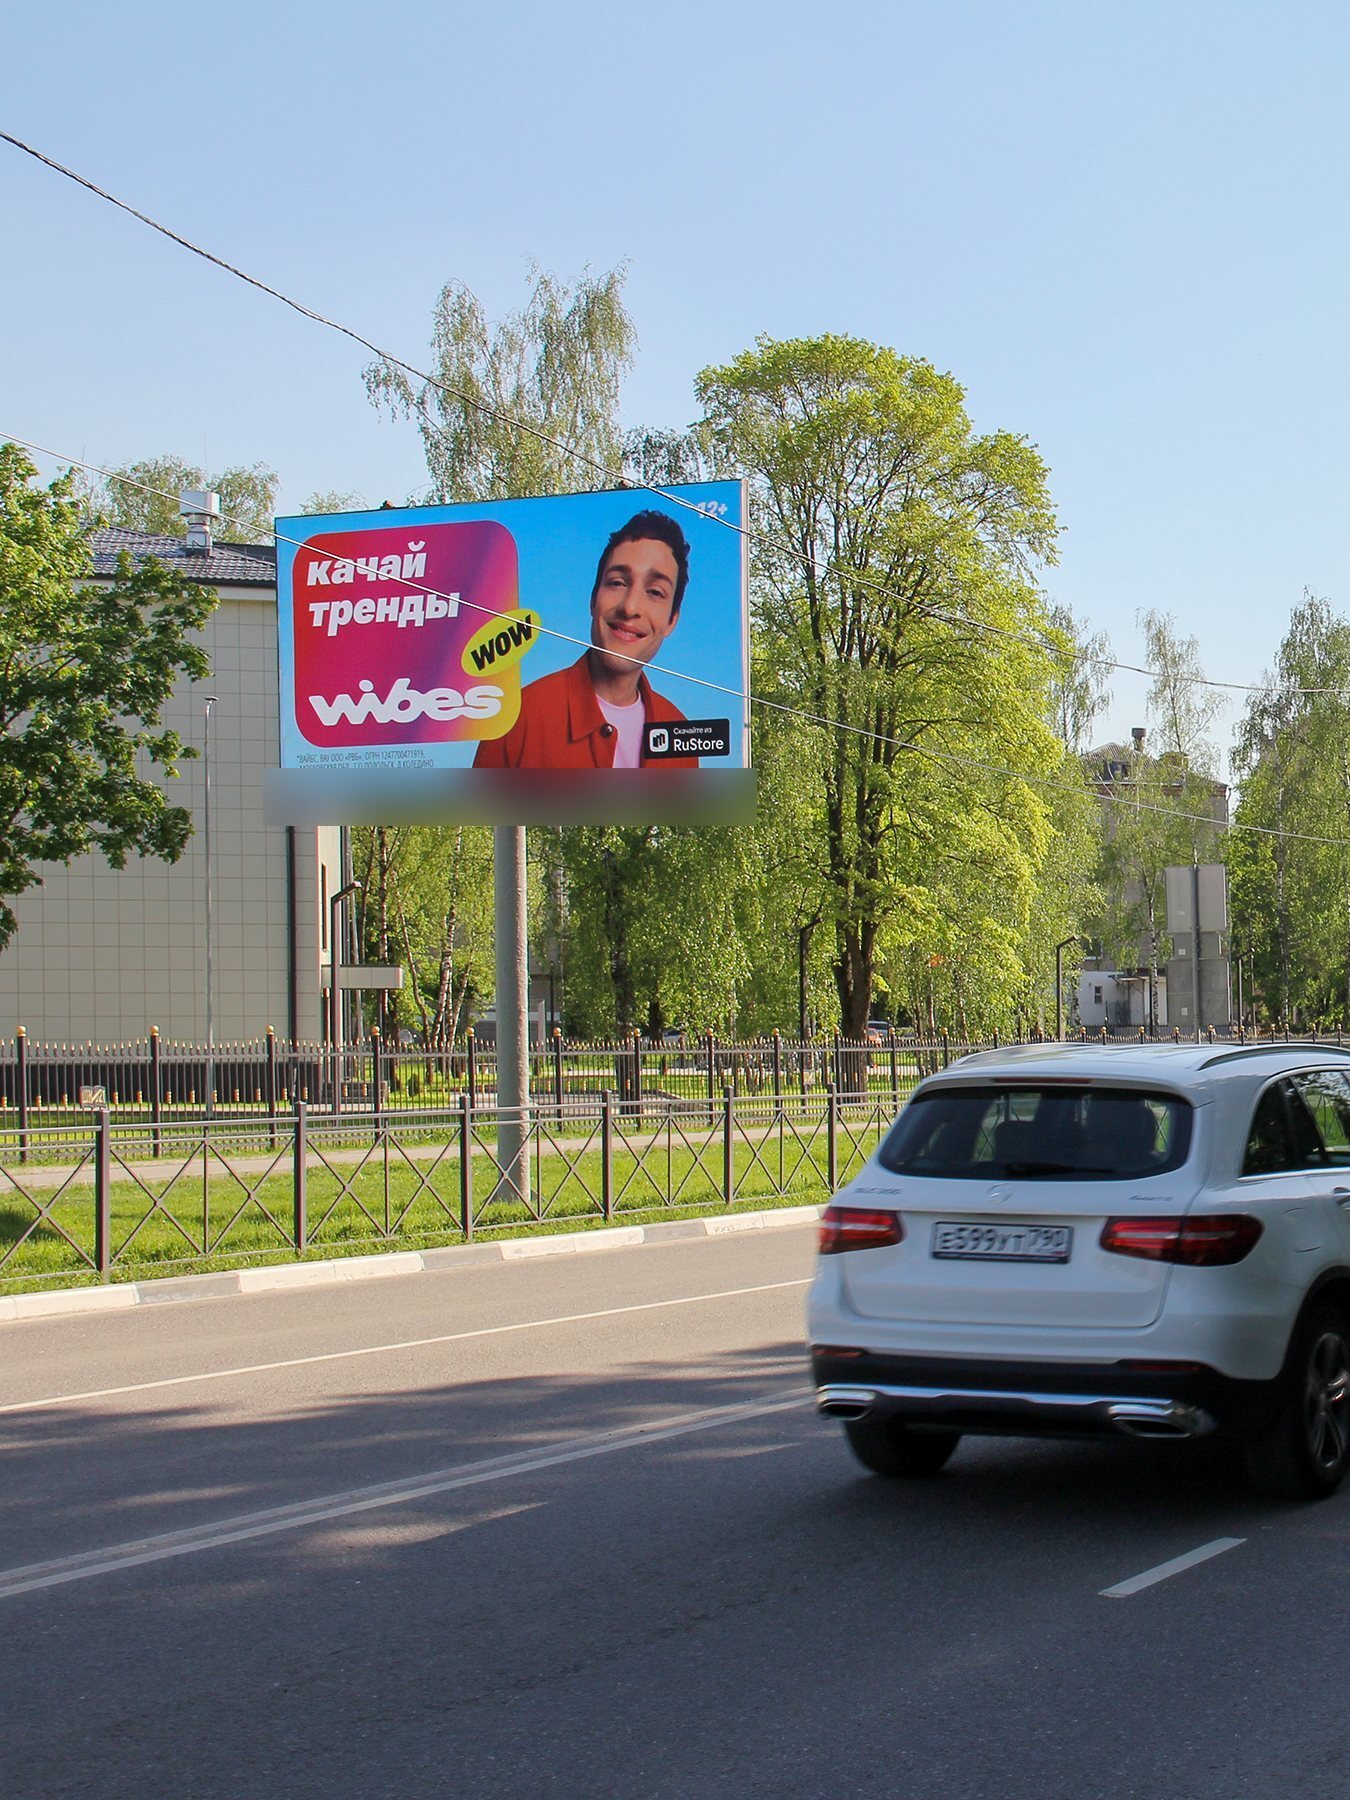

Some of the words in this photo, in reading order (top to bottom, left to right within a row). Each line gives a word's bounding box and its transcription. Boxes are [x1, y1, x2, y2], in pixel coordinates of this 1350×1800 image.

[697, 500, 728, 518] 12+
[307, 540, 427, 586] качай
[309, 592, 460, 637] тренды
[673, 726, 703, 735] Скачайте
[673, 738, 724, 751] RuStore
